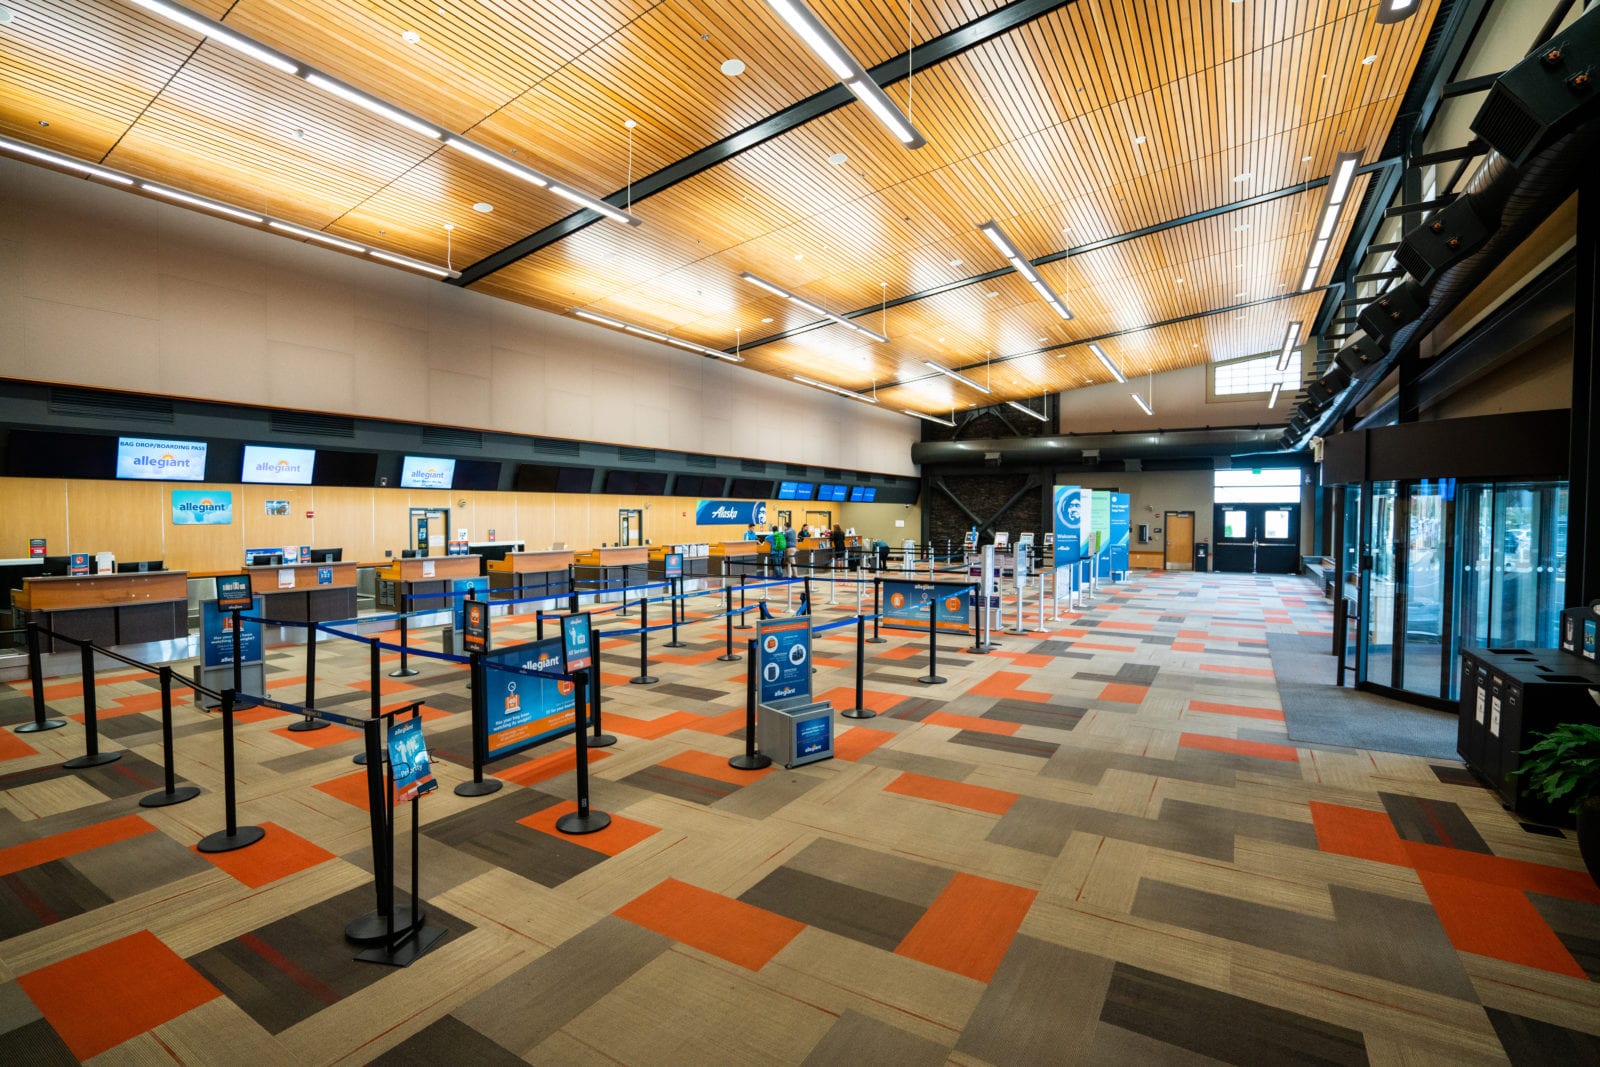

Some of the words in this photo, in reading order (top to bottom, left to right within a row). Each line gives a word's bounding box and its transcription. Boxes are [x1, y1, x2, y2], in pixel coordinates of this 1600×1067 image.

[135, 442, 190, 450] DROP/BOARDING
[133, 455, 191, 468] allegiant
[256, 462, 301, 473] allegiant
[411, 470, 444, 479] allegiant
[179, 502, 226, 513] allegiant
[711, 505, 738, 520] Alaska
[521, 655, 560, 671] allegiant
[774, 688, 796, 697] allegiant
[394, 724, 414, 736] allegiant
[400, 764, 423, 777] Priority
